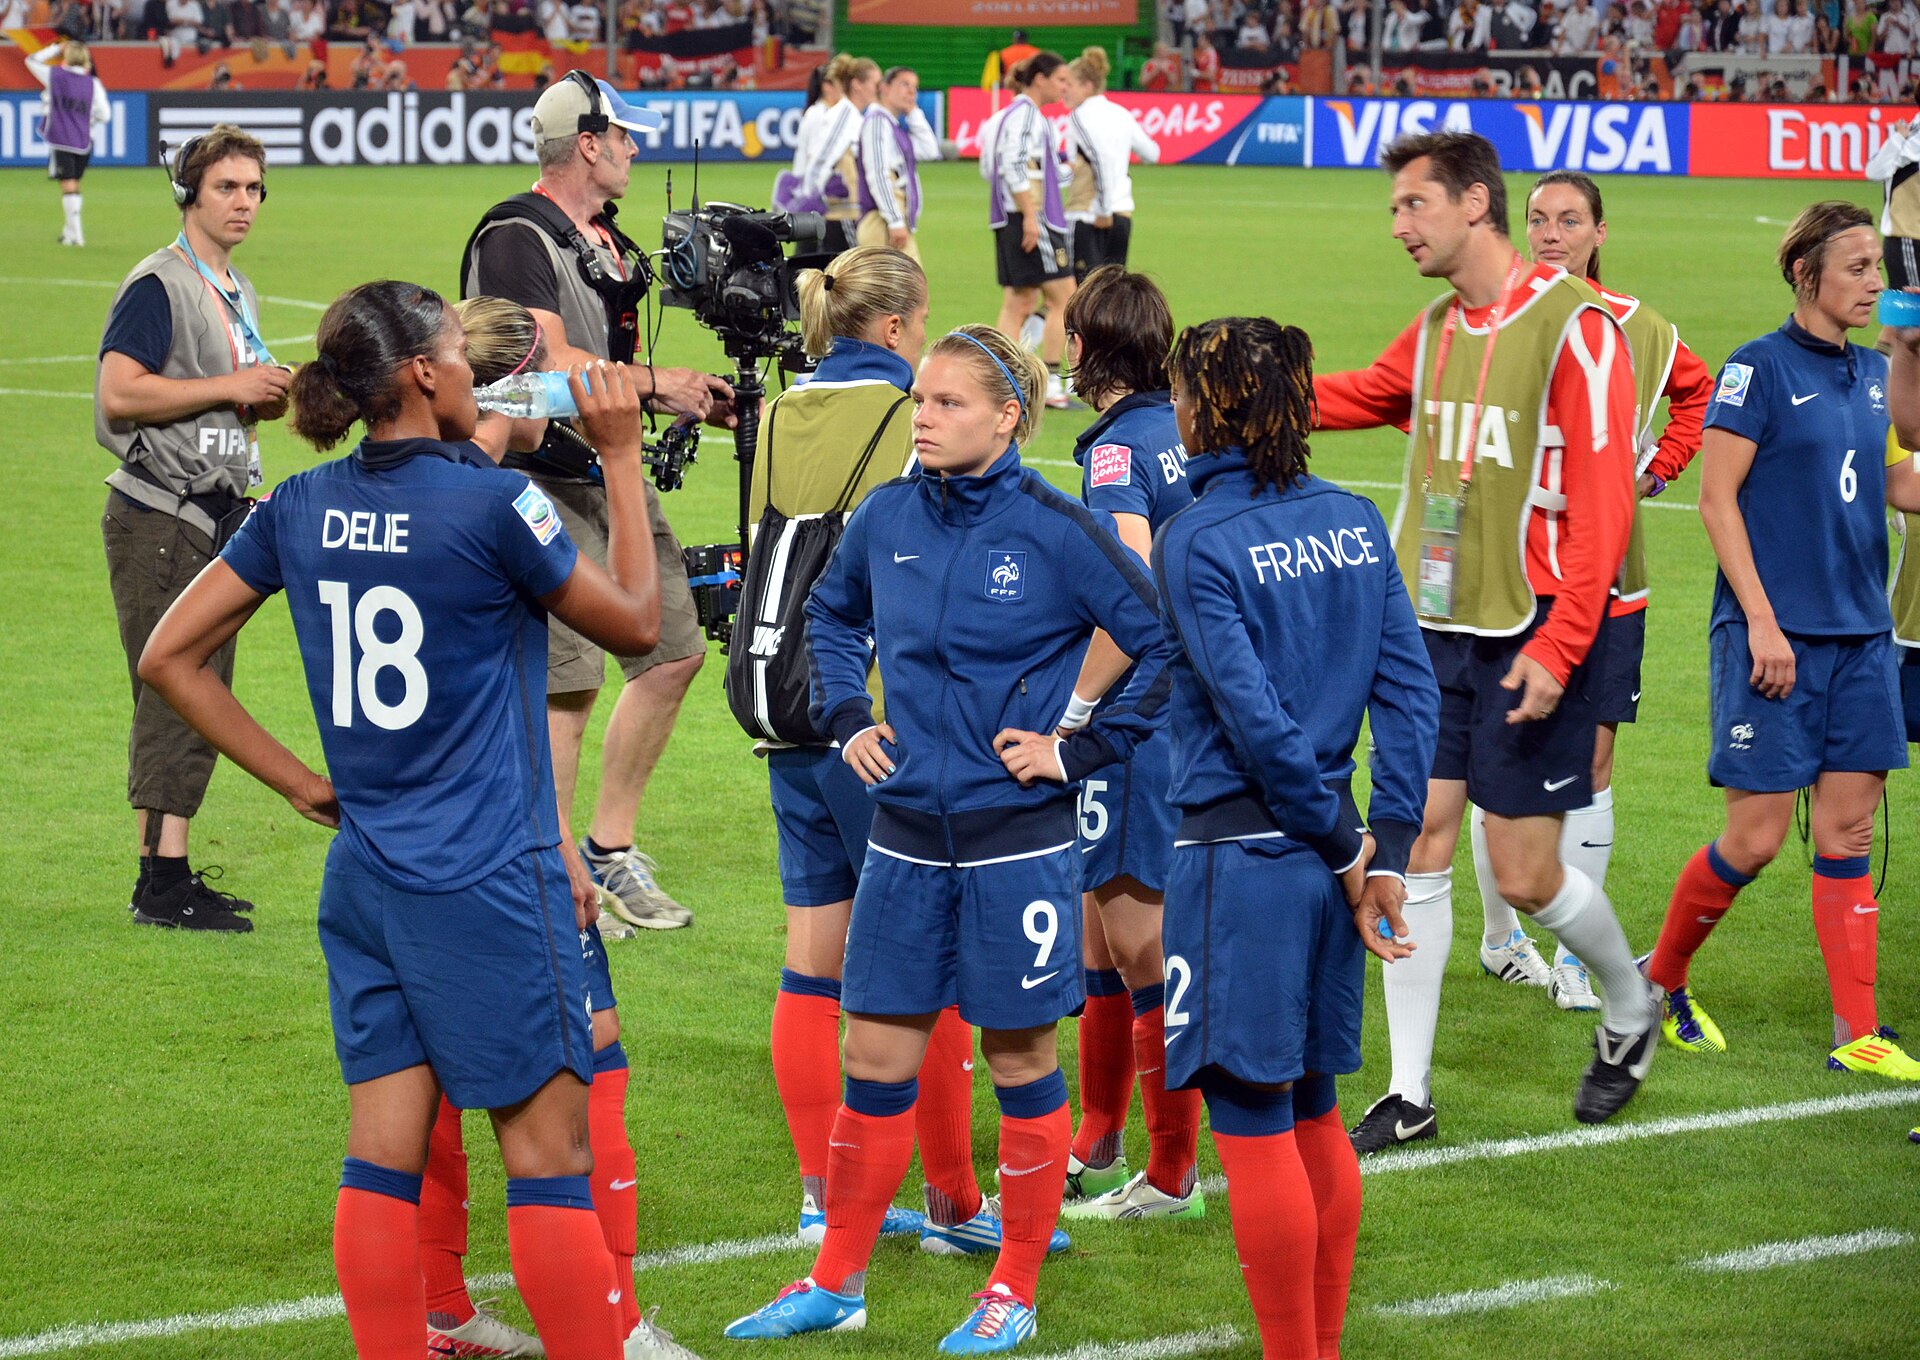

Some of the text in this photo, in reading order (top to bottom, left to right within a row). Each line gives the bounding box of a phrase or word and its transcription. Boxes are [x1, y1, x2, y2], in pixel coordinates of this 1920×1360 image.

[309, 91, 540, 165] adidas
[1257, 123, 1299, 142] FIFA
[1514, 103, 1673, 172] VISA
[199, 427, 246, 456] FIFA
[1093, 454, 1126, 471] YOUR
[1094, 446, 1119, 461] LIVE
[1093, 462, 1128, 482] GOALS
[1839, 449, 1858, 503] 6
[322, 509, 409, 553] DELIE
[1248, 526, 1380, 584] FRANCE
[990, 588, 1017, 597] FFF
[318, 580, 429, 730] 18
[1077, 779, 1109, 841] 5
[1022, 900, 1058, 967] 9
[1163, 955, 1191, 1027] 2
